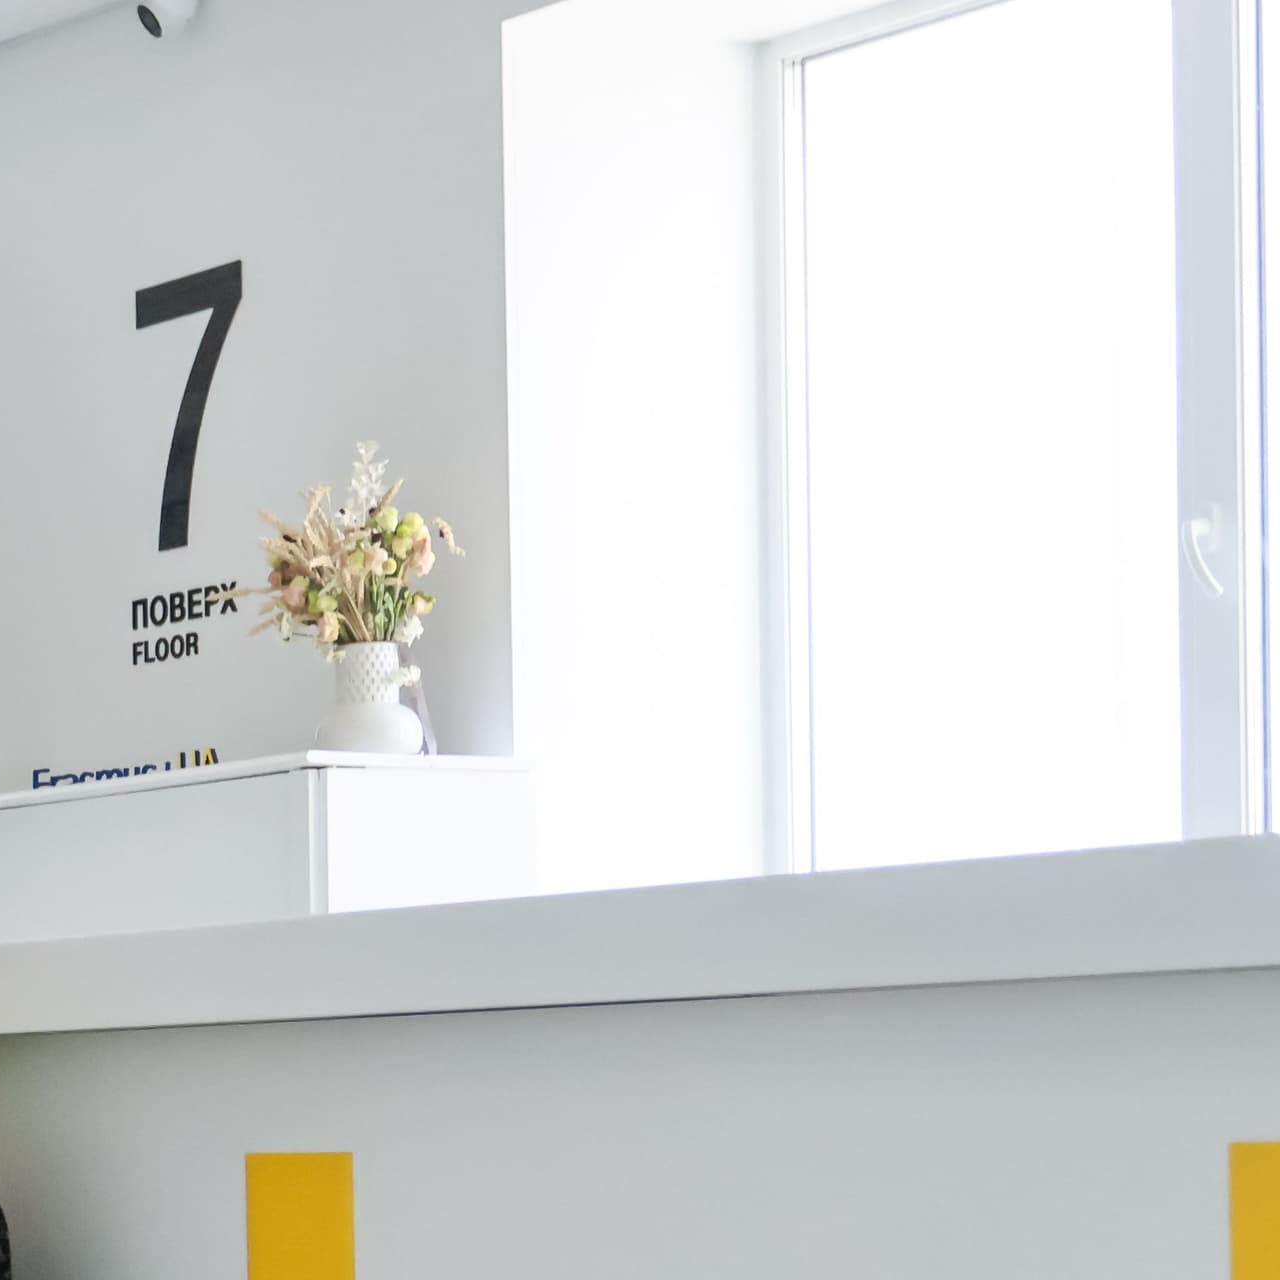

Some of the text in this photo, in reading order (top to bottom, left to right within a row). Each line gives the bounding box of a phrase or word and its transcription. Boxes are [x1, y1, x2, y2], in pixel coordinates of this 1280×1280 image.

[136, 260, 242, 551] 7
[132, 581, 238, 631] ПОВЕРХ
[132, 632, 199, 666] FLOOR
